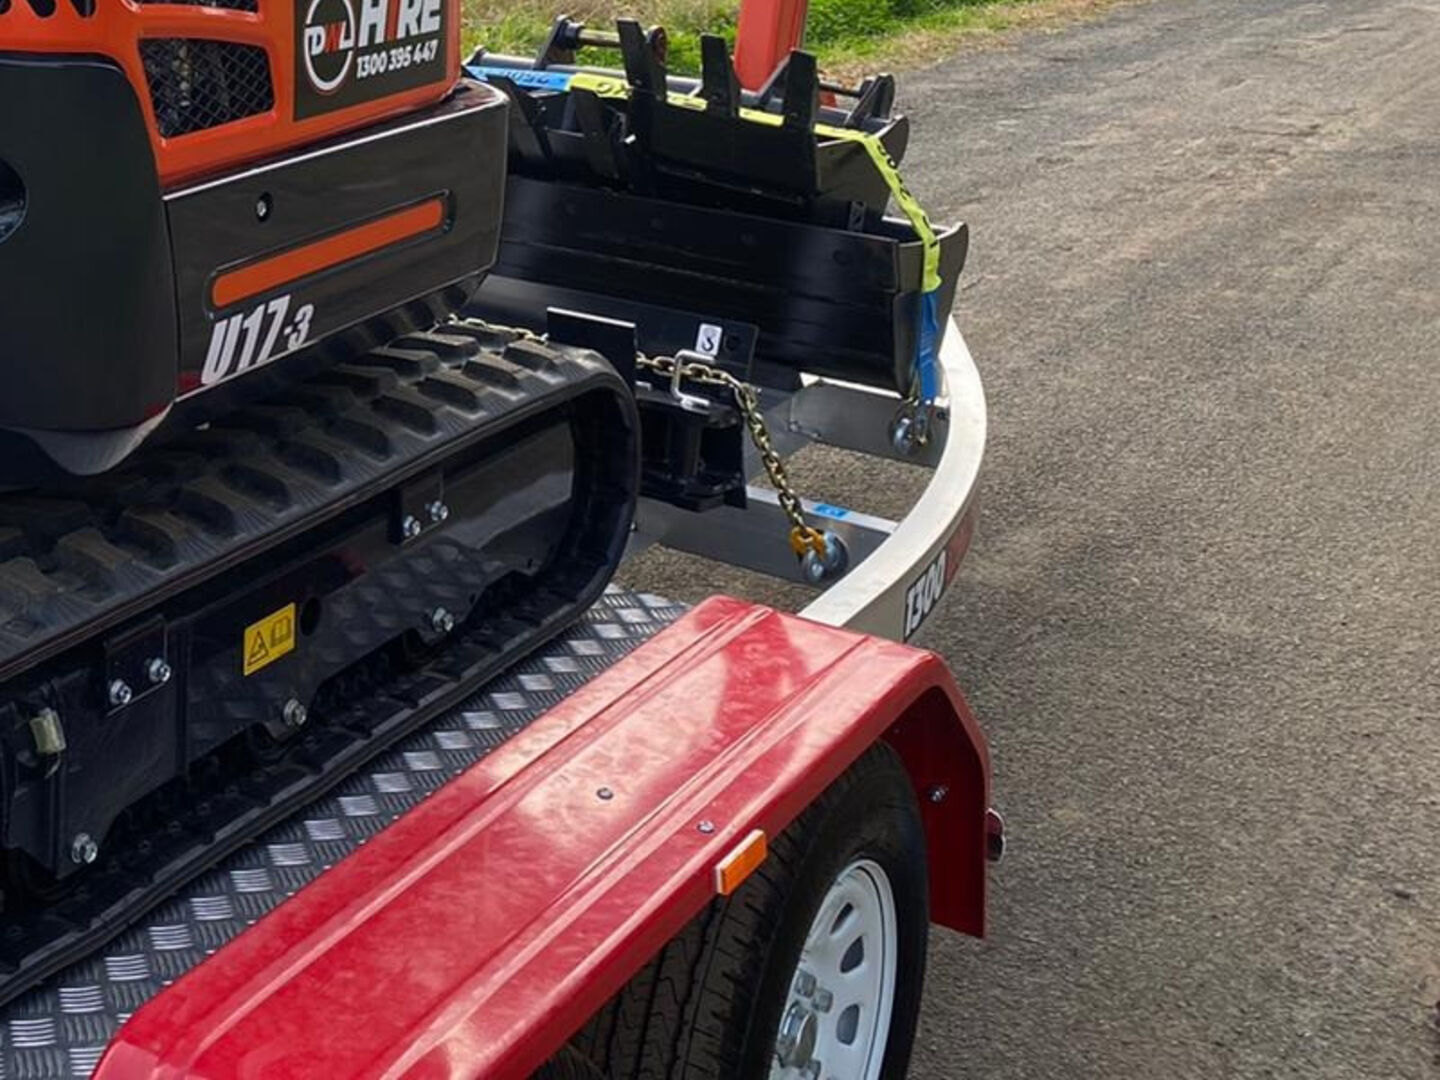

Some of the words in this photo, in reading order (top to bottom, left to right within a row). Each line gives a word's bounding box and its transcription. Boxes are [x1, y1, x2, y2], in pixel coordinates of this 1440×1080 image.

[356, 51, 387, 78] 1300
[388, 44, 412, 71] 395
[413, 39, 439, 66] 447
[201, 294, 314, 385] U17-3
